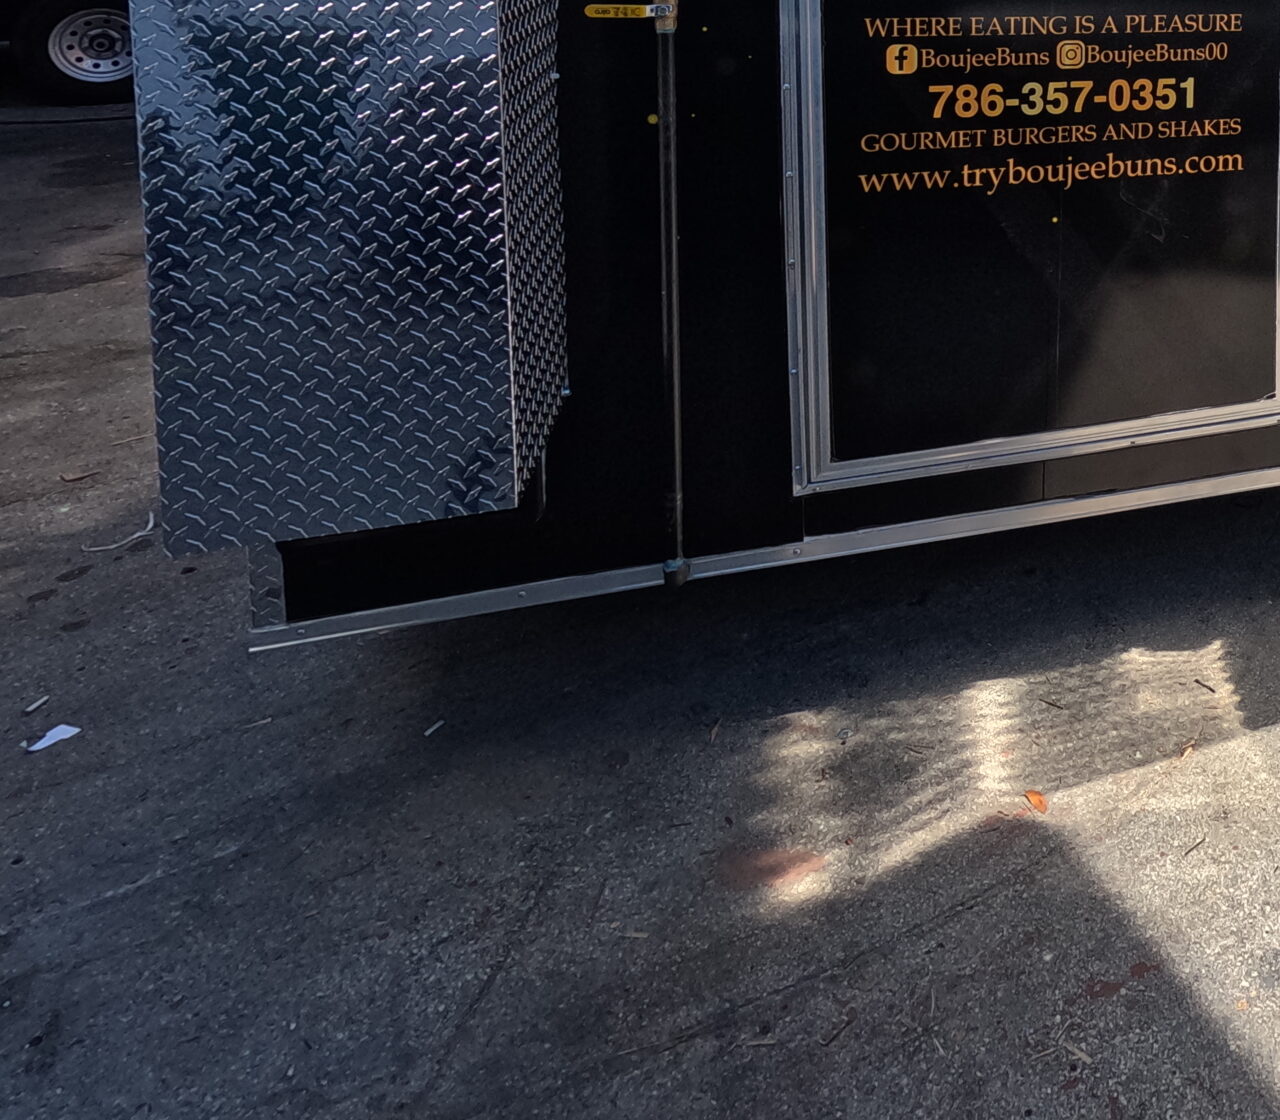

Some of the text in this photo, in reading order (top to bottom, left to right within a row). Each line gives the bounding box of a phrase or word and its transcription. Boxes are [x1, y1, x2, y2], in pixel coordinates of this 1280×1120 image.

[864, 13, 1243, 38] WHERE EATING IS A PLEASURE
[921, 47, 1050, 74] BoujeeBuns
[1087, 42, 1228, 69] BoujeeBuns00
[928, 77, 1195, 119] 786-357-0351
[860, 117, 1242, 153] GOURMET BURGERS AND SHAKES
[858, 152, 1245, 195] www.tryboujeebuns.com
